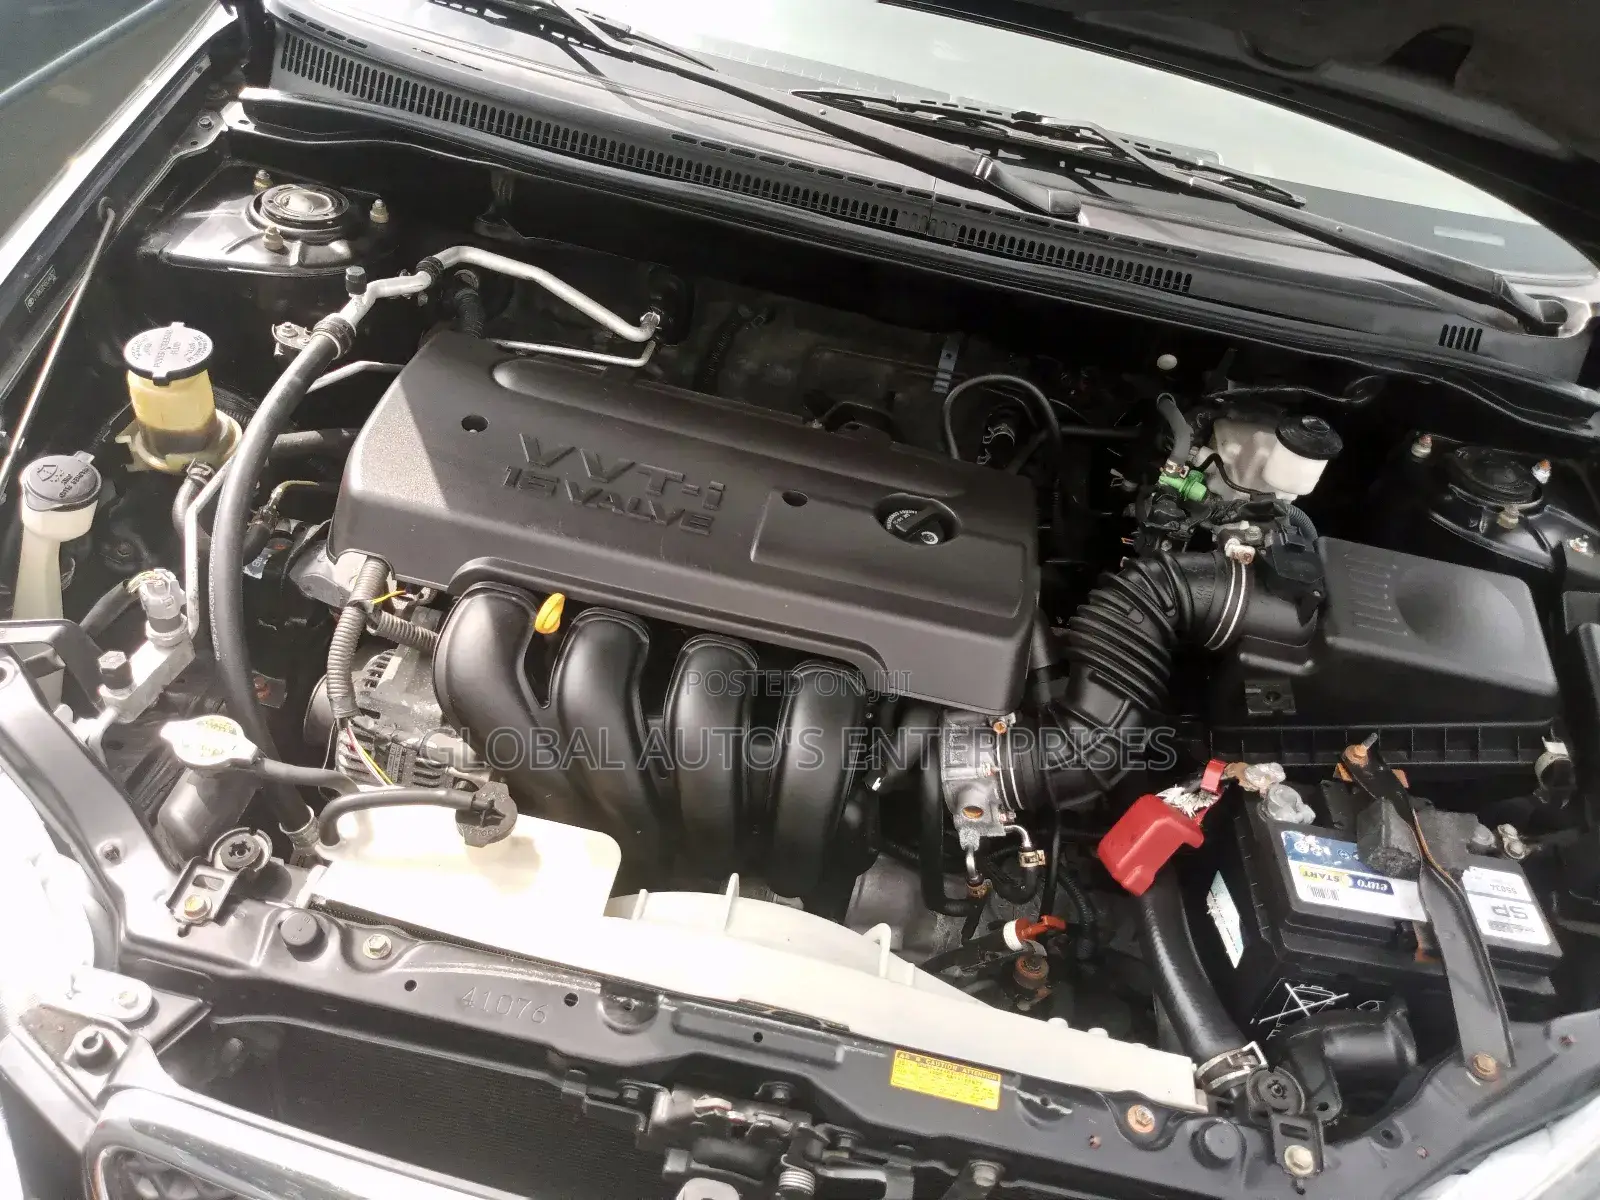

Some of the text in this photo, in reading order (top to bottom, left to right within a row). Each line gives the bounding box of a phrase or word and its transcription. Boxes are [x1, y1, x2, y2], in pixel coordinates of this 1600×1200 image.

[502, 465, 715, 536] 16 VALVE
[1303, 870, 1388, 891] euro START
[461, 986, 550, 1024] 41076
[926, 1058, 999, 1081] CAUTION ATTENTION
